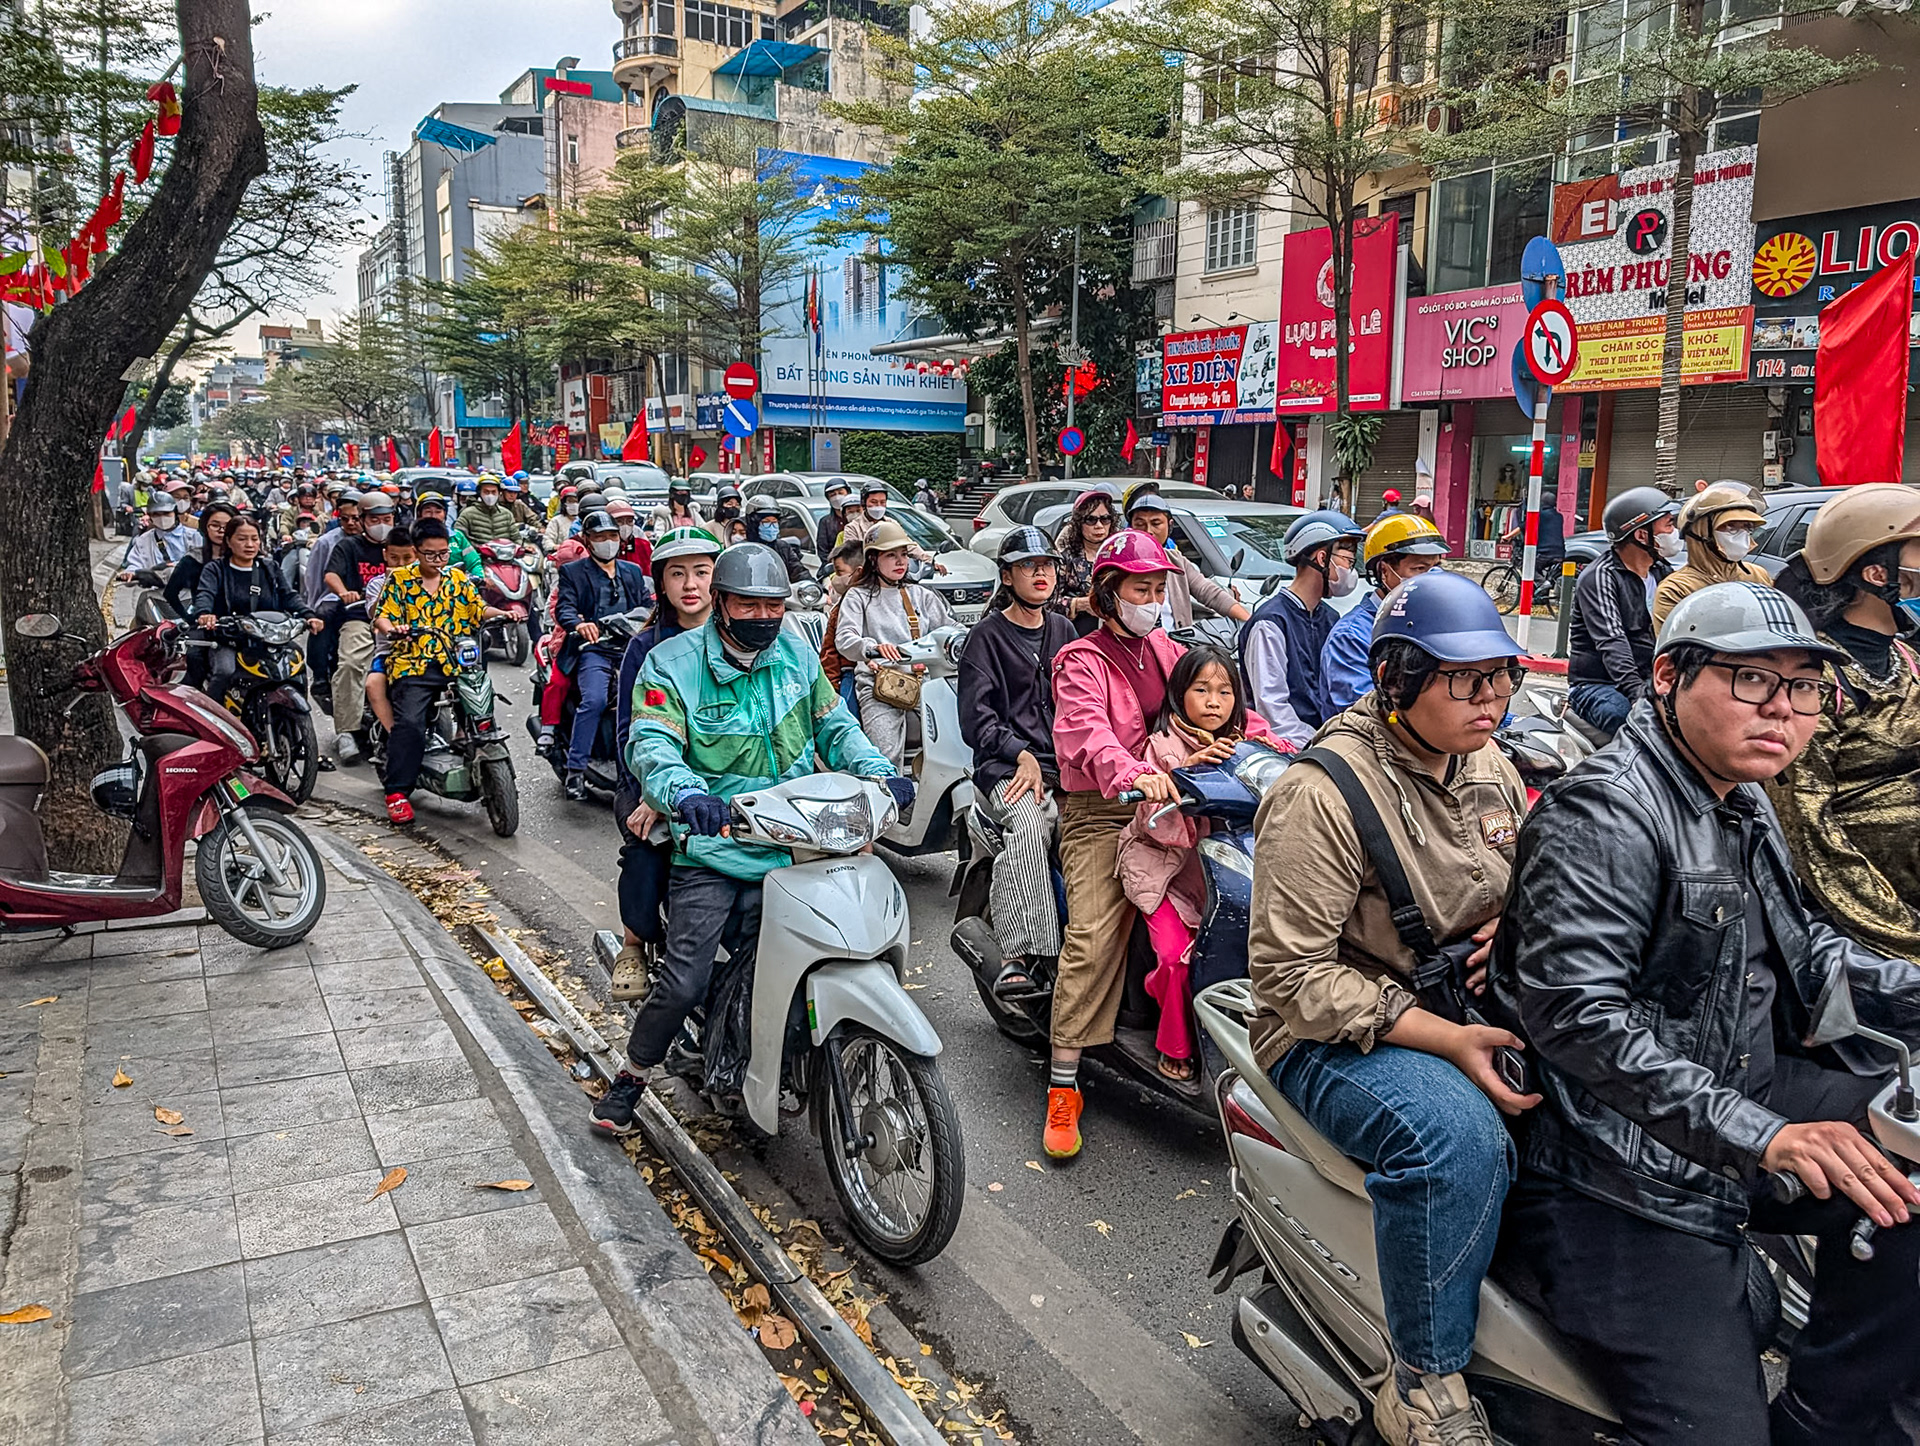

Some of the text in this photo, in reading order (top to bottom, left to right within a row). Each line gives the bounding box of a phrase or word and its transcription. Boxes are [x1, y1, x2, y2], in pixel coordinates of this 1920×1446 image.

[1565, 262, 1616, 299] RÈM
[1443, 315, 1499, 345] VIC'S
[1687, 331, 1719, 346] KHỎE
[1441, 345, 1497, 368] SHOP
[1600, 340, 1633, 353] CHĂM
[1636, 338, 1660, 350] SÓC
[776, 362, 804, 381] BẤT
[853, 367, 881, 385] SẢN
[1165, 353, 1237, 389] XE ĐIỆN
[1756, 358, 1787, 378] 114
[825, 865, 857, 875] HONDA
[1266, 1196, 1360, 1281] LEAD
